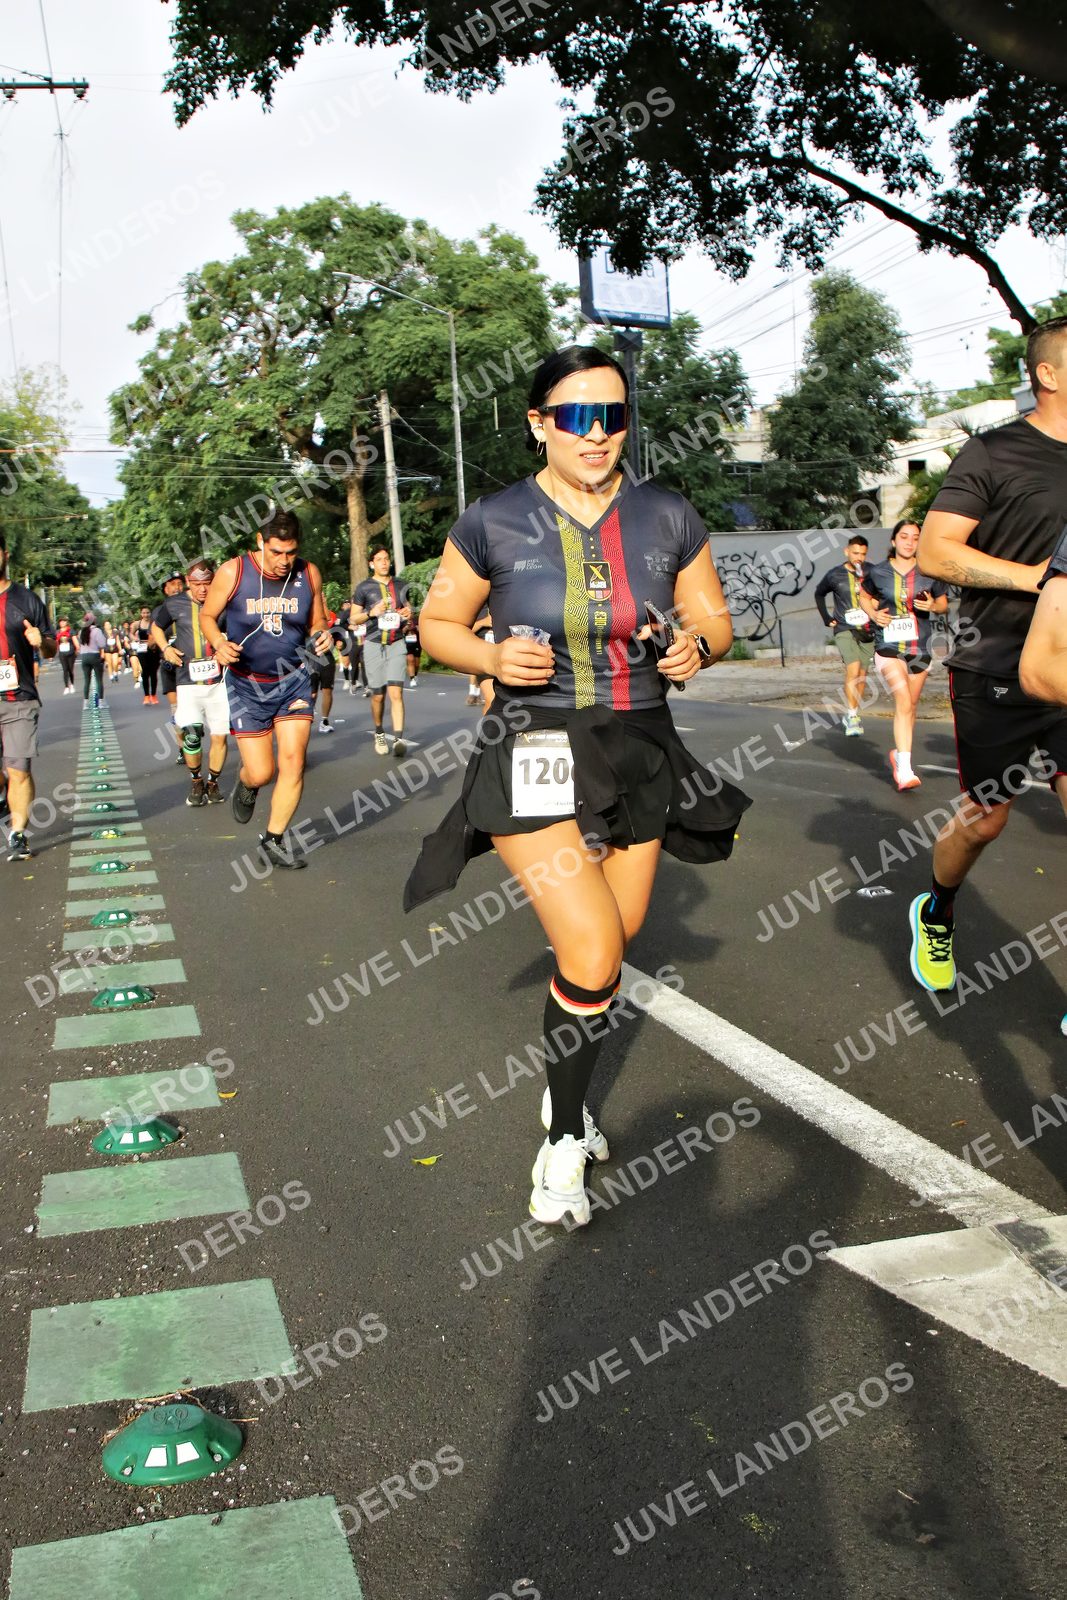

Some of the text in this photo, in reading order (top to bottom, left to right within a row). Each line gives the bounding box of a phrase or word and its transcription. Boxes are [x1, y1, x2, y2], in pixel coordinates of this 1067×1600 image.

[246, 597, 299, 615] NUGGETS
[191, 662, 216, 673] 13238
[518, 757, 574, 785] 120
